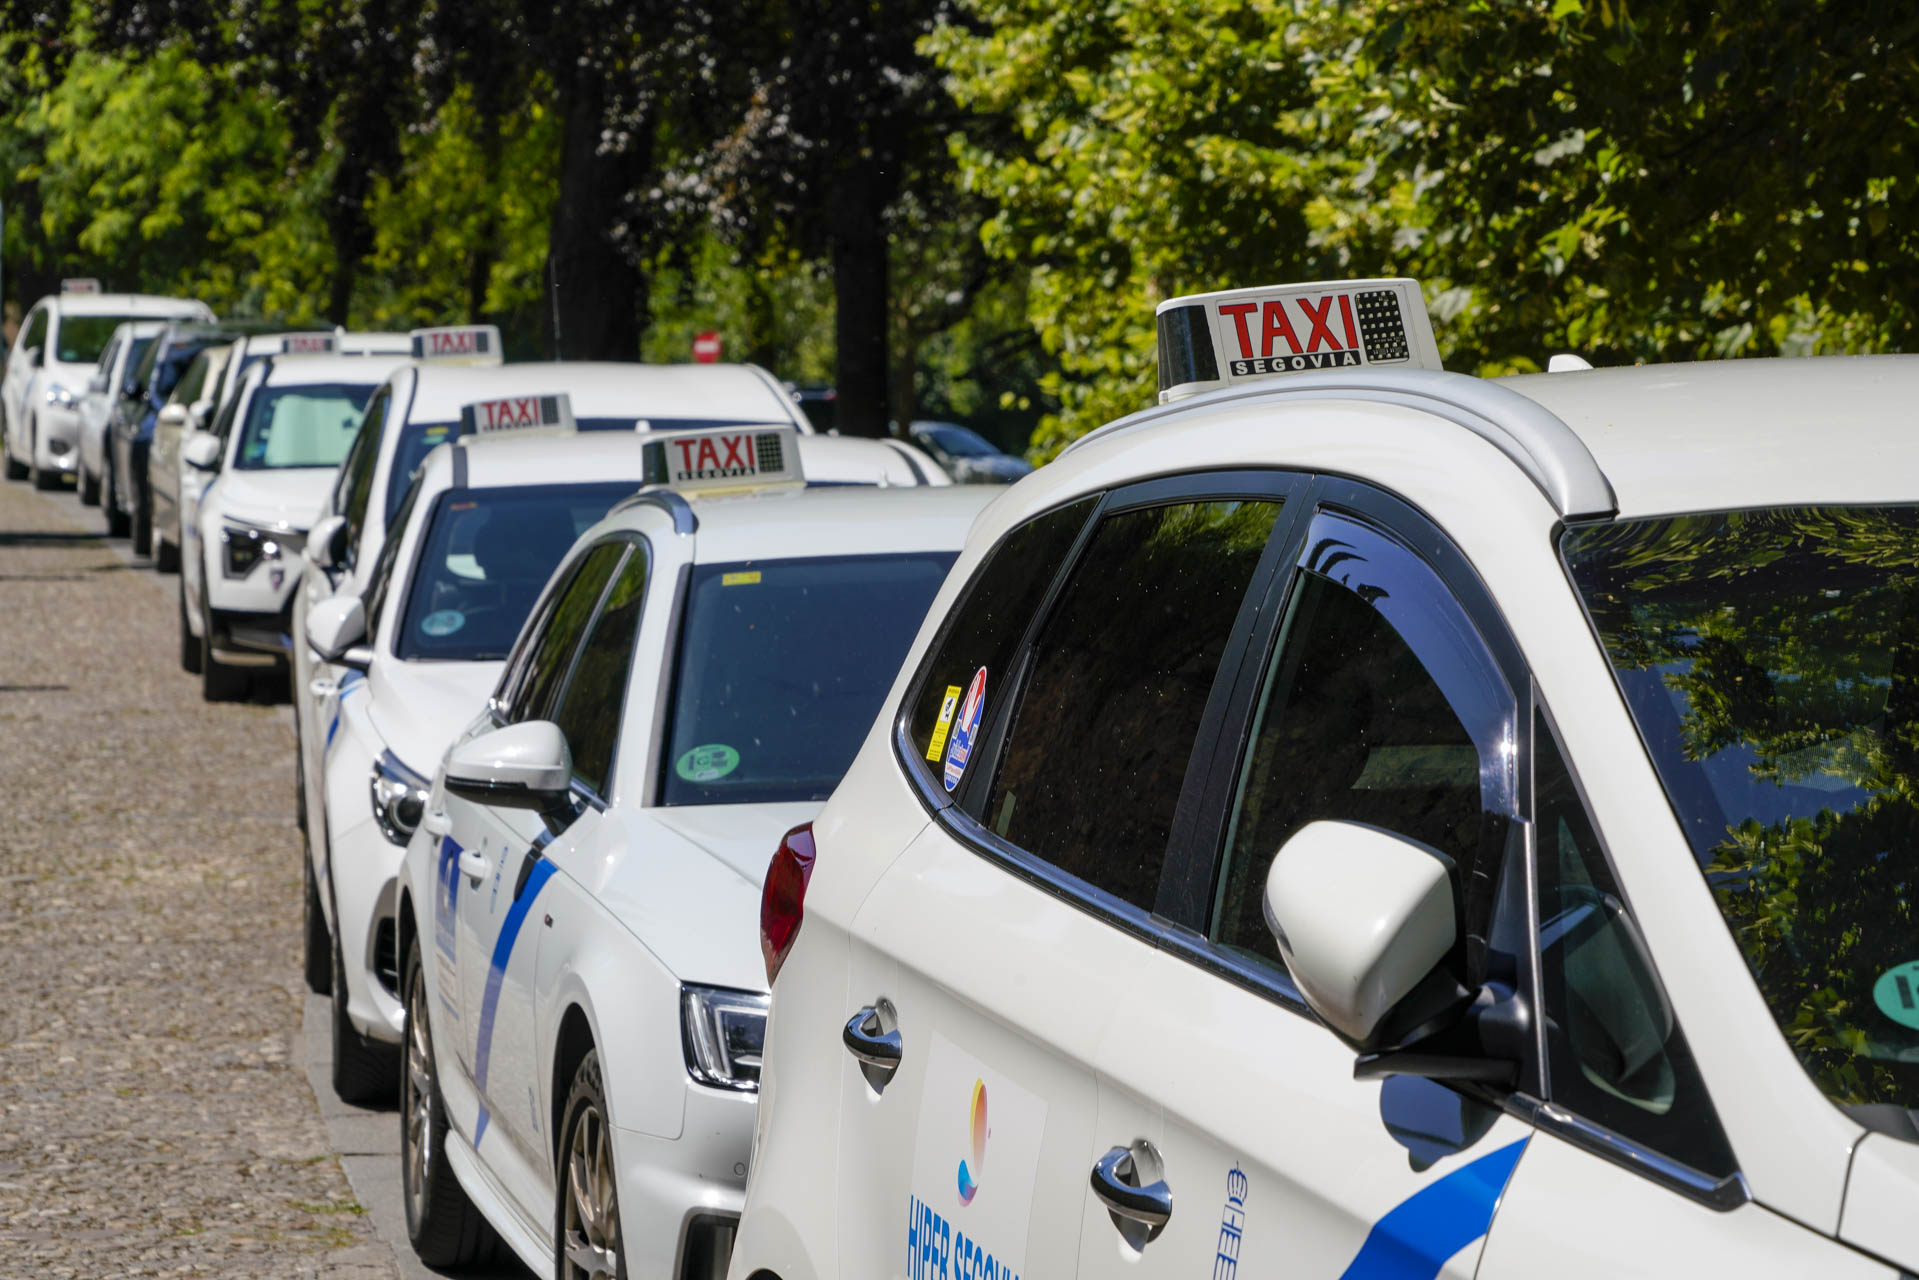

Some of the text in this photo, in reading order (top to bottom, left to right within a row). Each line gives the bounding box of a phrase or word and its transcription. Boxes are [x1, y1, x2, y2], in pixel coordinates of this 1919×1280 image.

[1218, 294, 1359, 359] TAXI
[431, 332, 475, 352] TAXI
[1235, 352, 1357, 375] SEGOVIA
[481, 397, 539, 425] TAXI
[674, 435, 755, 471] TAXI
